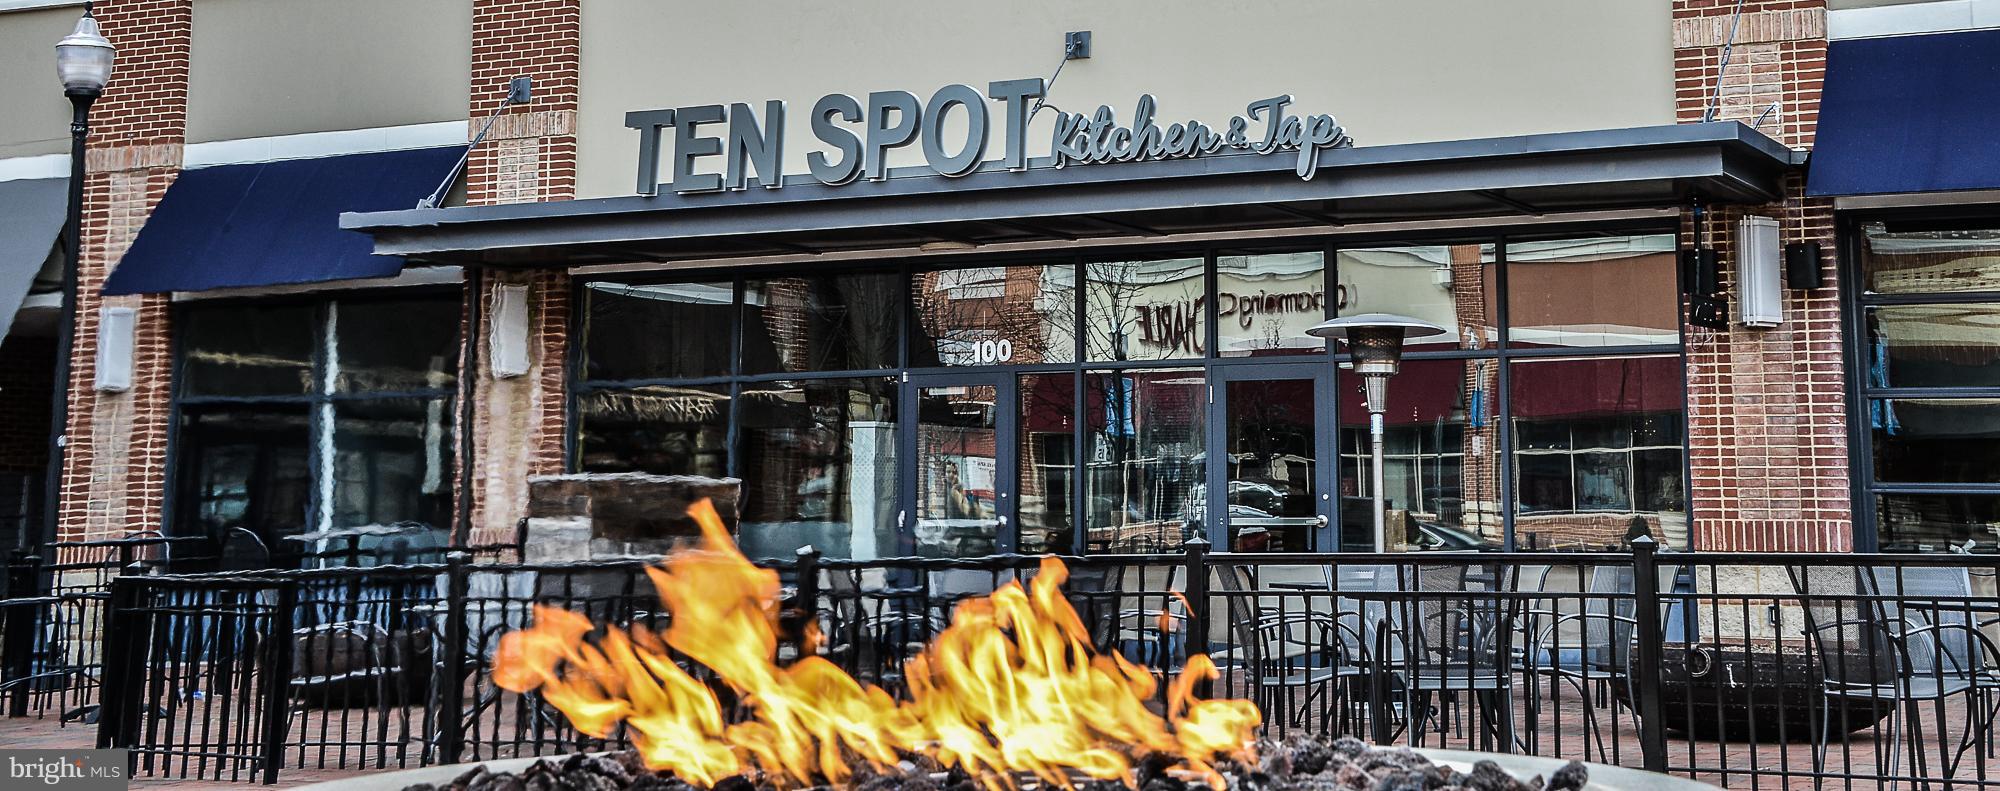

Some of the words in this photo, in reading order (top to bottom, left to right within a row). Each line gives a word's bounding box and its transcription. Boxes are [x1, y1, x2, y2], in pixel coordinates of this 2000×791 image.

[624, 98, 785, 197] TEN
[806, 77, 1047, 188] SPOT
[1050, 93, 1225, 171] Kitchen
[1225, 115, 1251, 149] &
[1246, 94, 1347, 181] Tap
[971, 338, 1012, 363] 100
